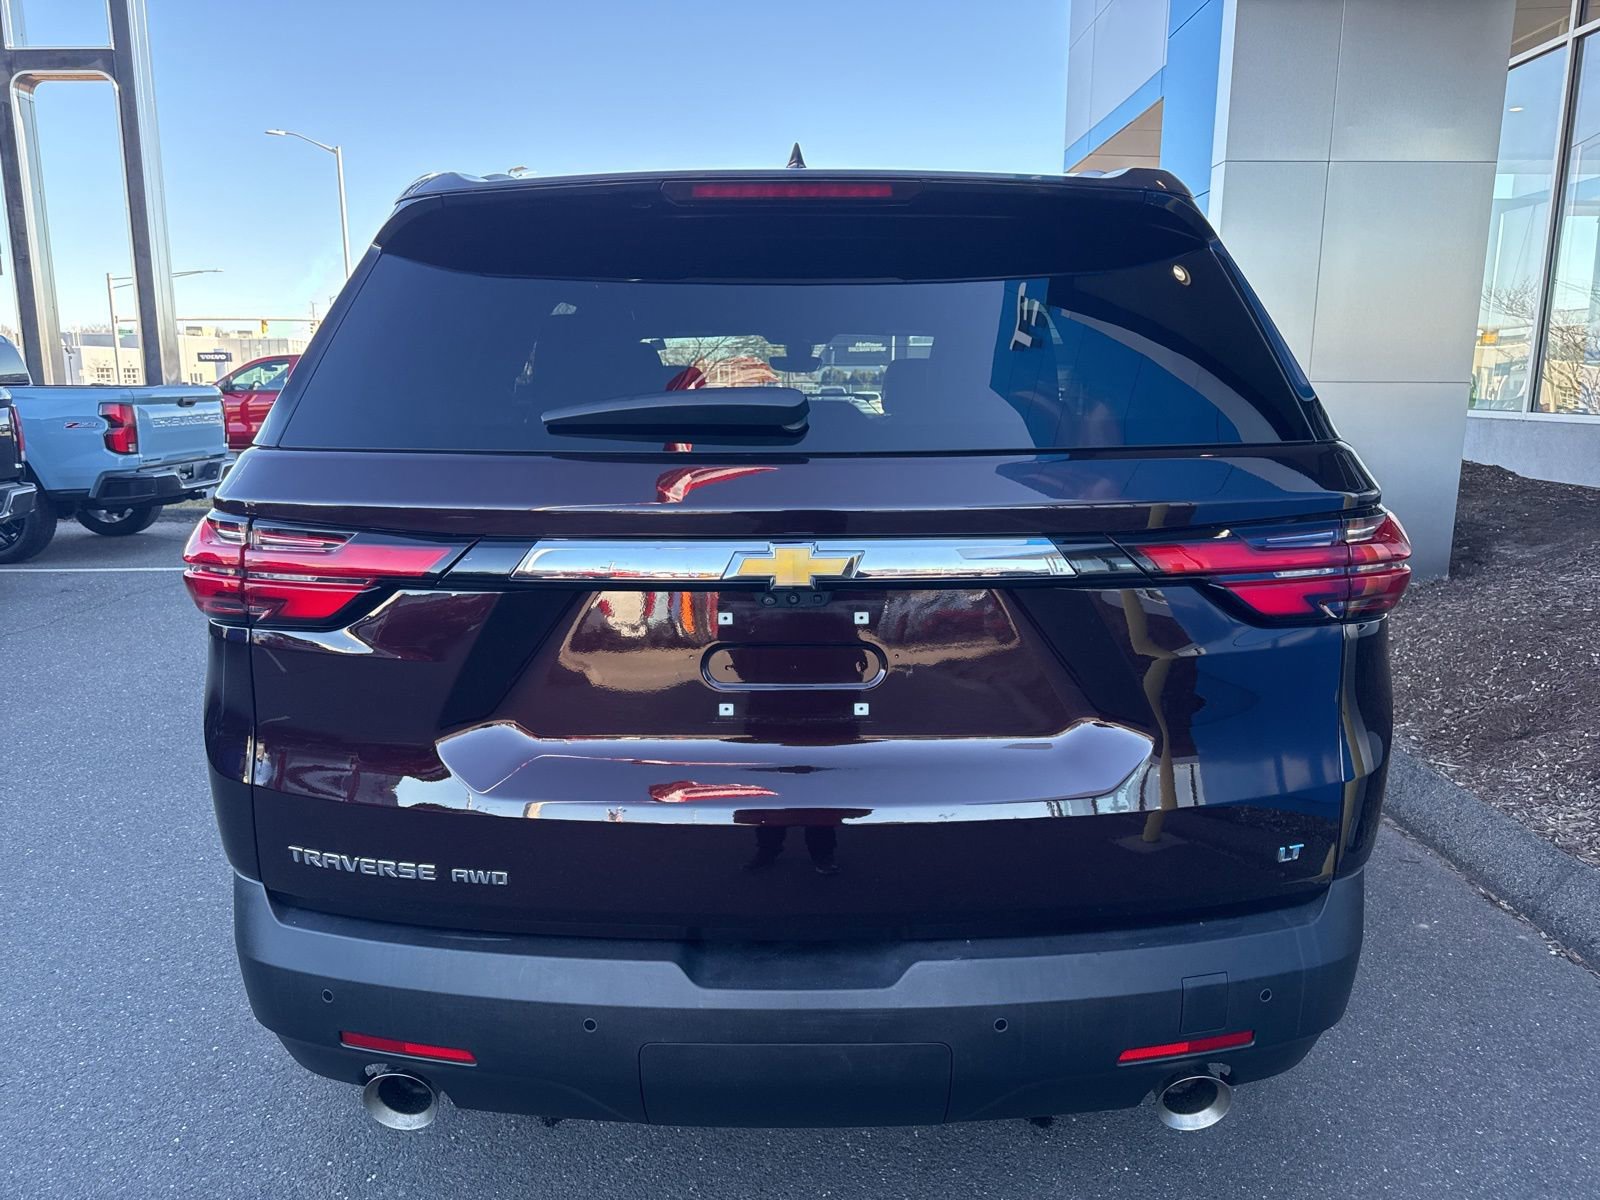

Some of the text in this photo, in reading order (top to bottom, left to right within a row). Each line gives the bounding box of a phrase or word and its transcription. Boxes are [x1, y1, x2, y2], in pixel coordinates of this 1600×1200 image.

[288, 845, 509, 886] TRAVERSE AWD
[1278, 843, 1305, 864] LT
